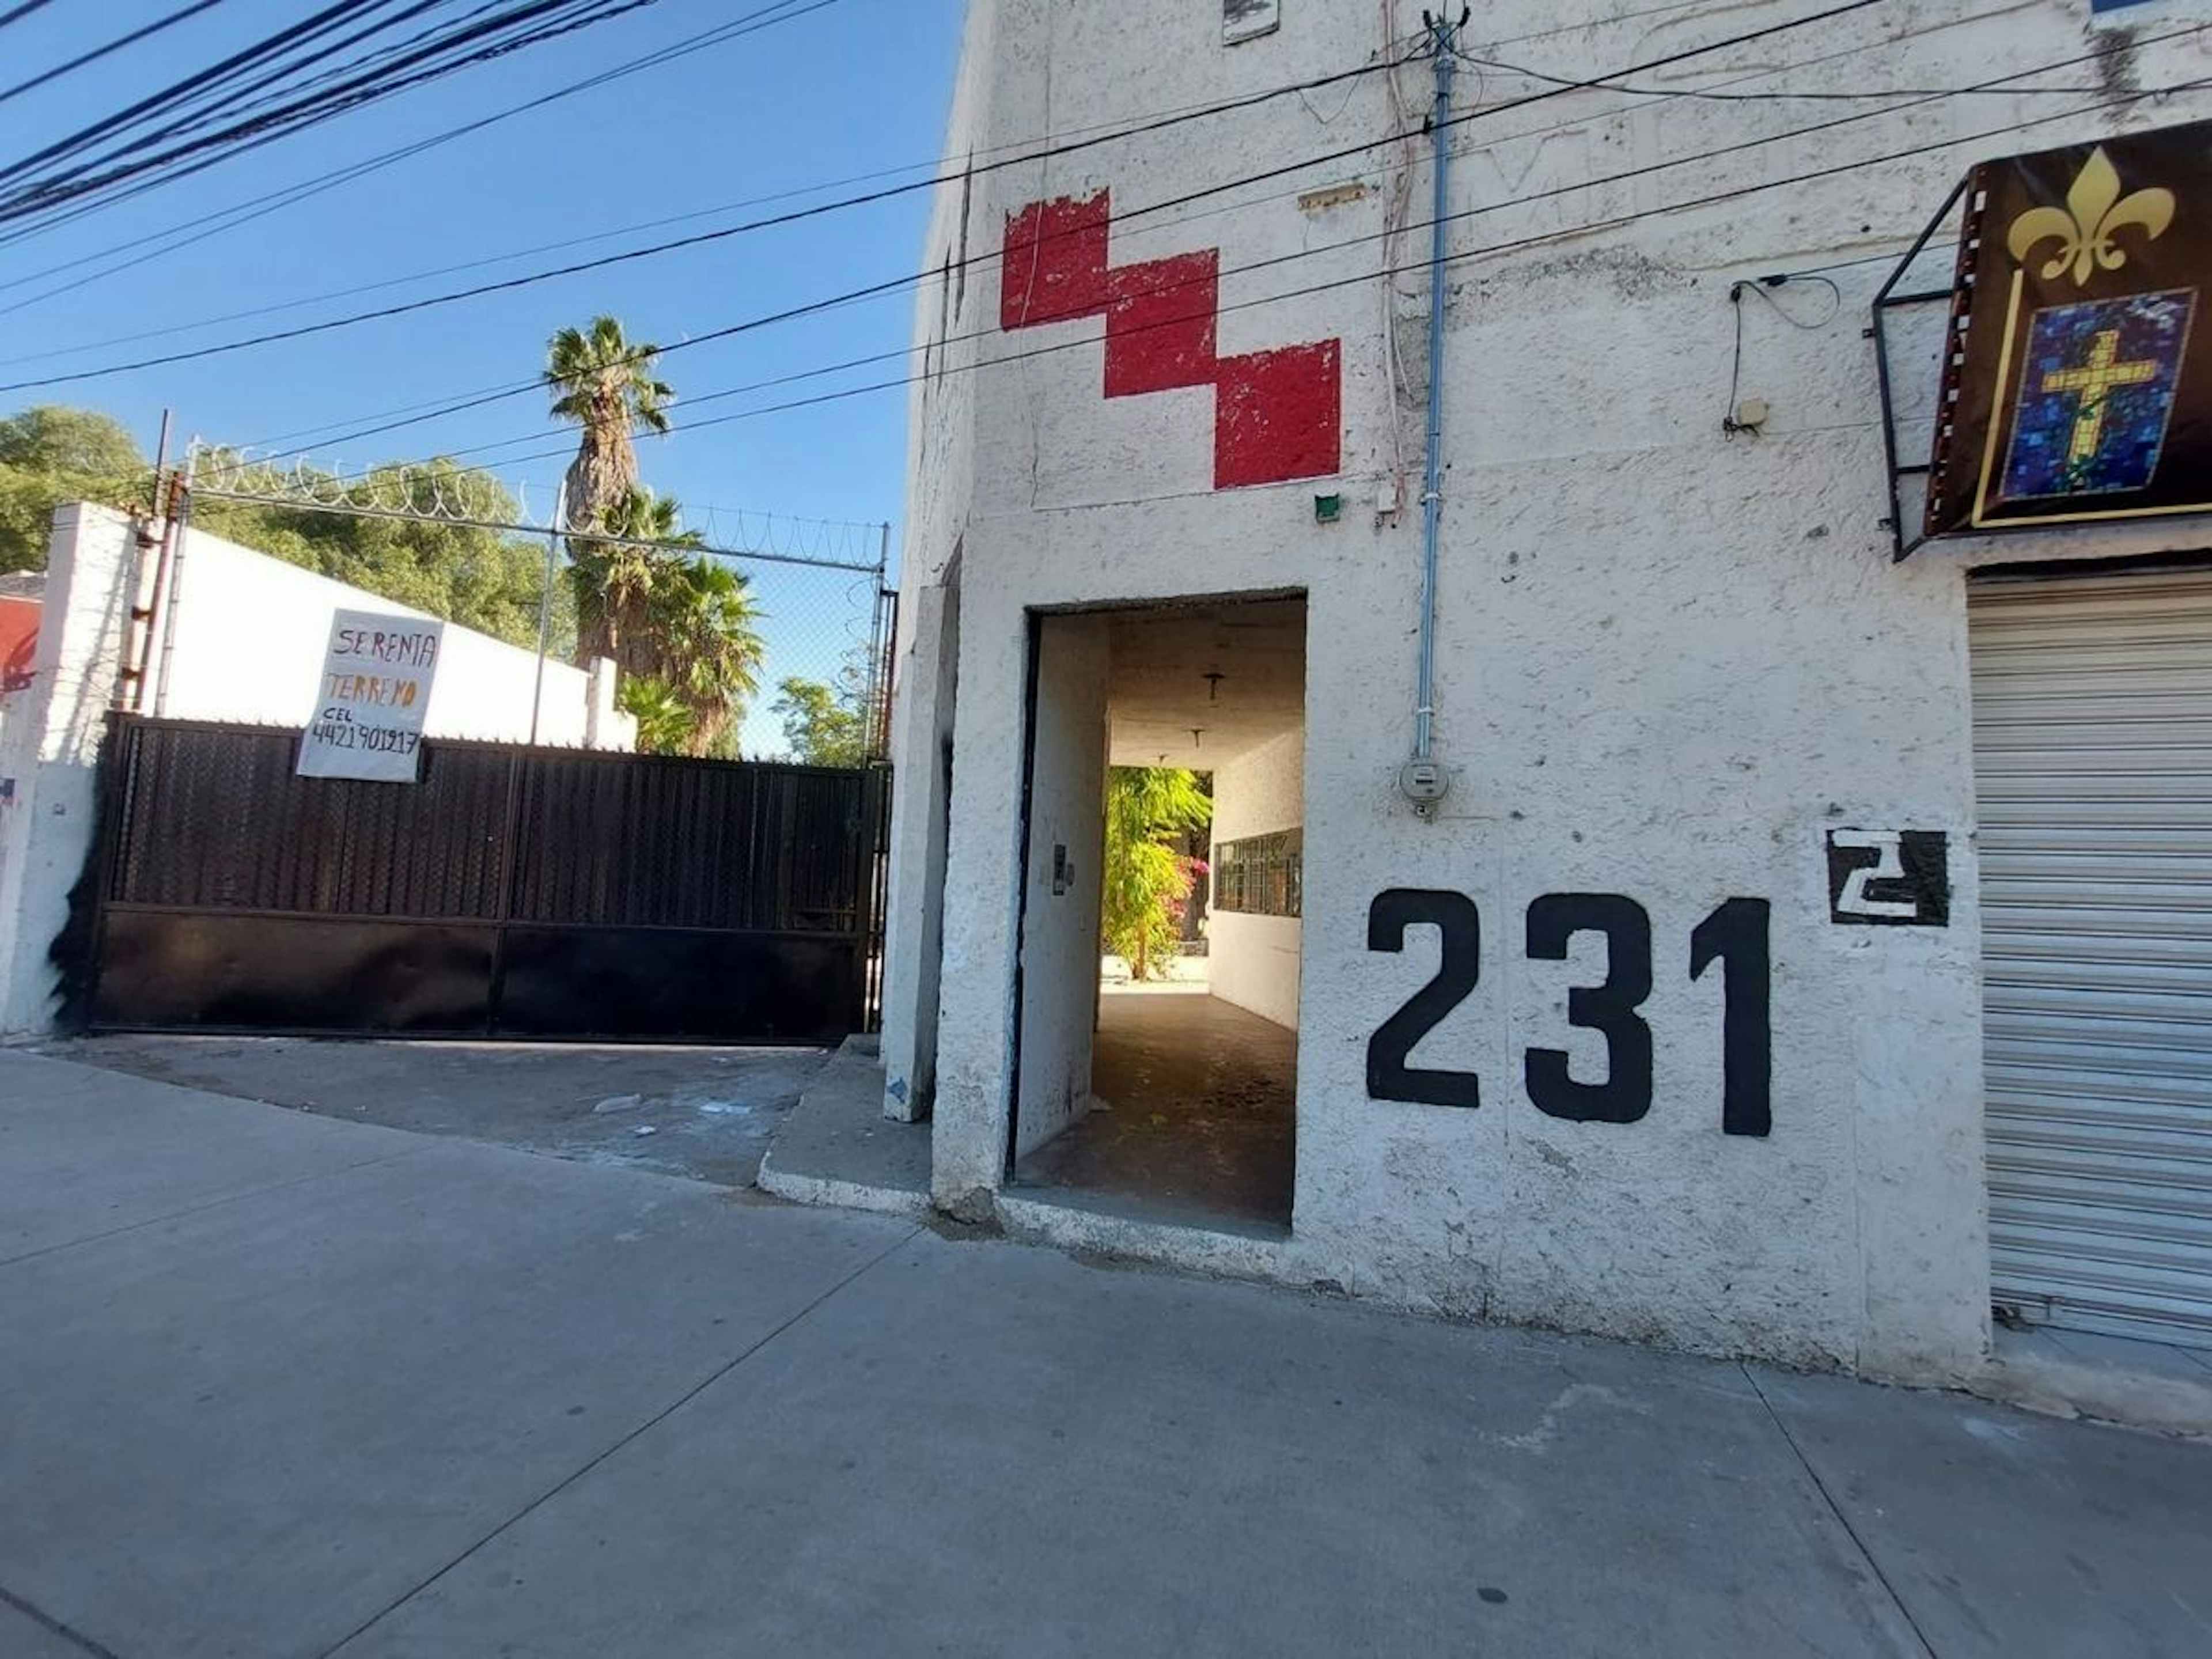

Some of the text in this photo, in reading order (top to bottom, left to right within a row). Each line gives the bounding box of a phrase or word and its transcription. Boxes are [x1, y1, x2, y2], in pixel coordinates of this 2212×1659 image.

[334, 630, 436, 668] SE RENTA
[323, 707, 353, 722] CEL
[1367, 888, 1772, 1137] 231
